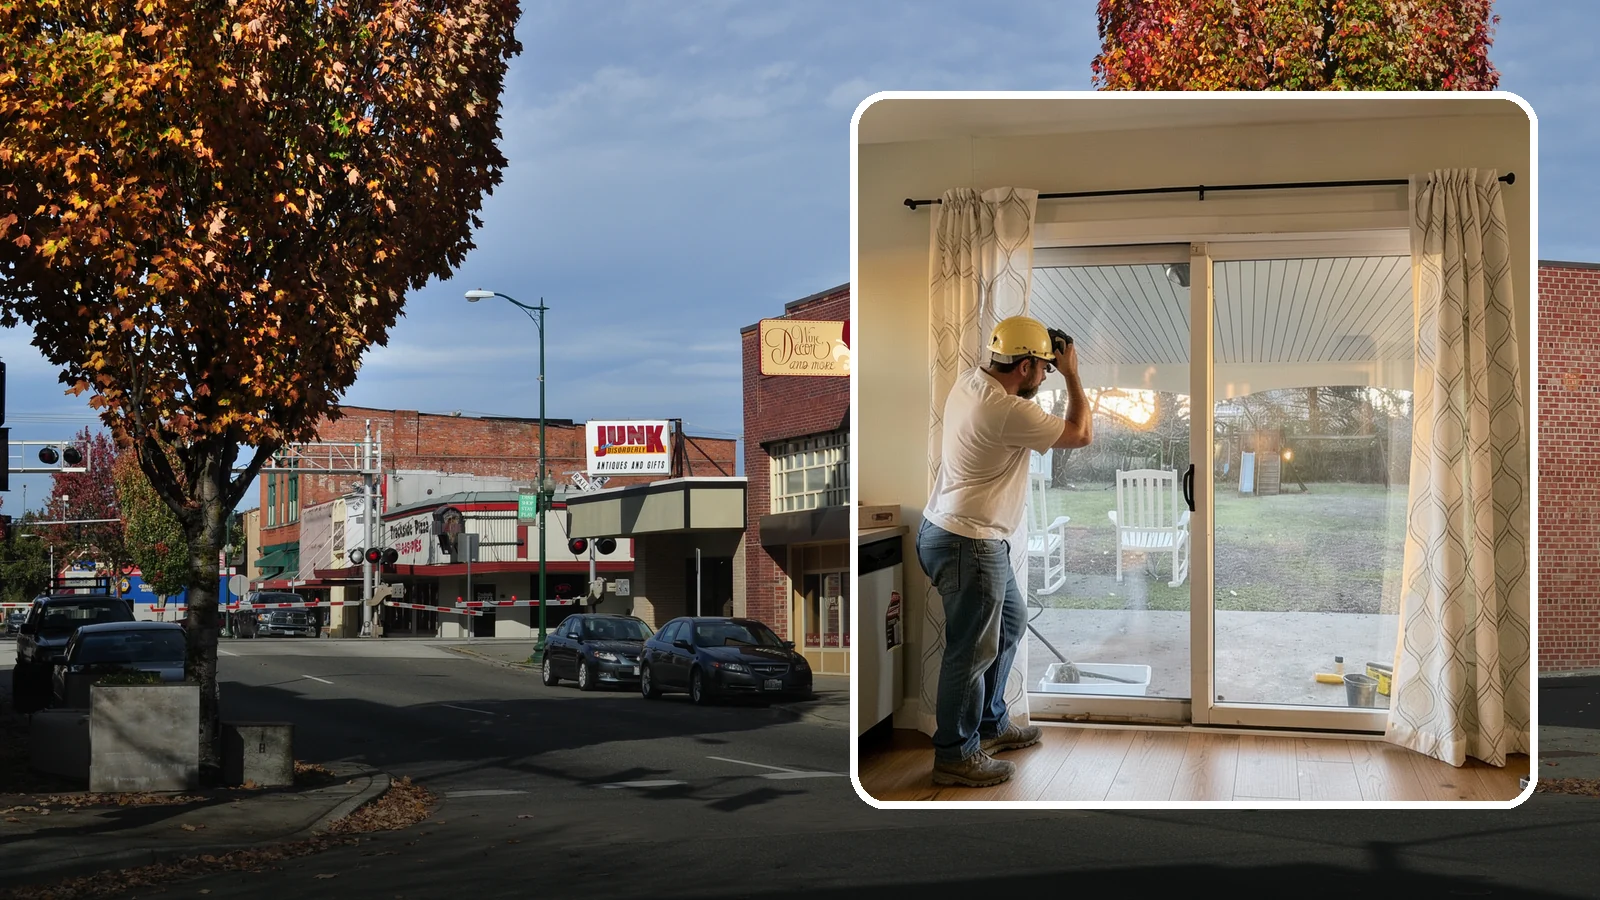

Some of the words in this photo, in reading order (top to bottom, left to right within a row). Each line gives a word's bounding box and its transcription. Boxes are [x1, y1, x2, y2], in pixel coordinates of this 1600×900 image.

[765, 327, 831, 365] Decor
[595, 425, 665, 457] JUNK
[607, 446, 645, 454] DISORDERLY
[596, 461, 628, 470] ANTIQUES
[631, 461, 643, 470] AND
[646, 460, 665, 469] GIFTS
[414, 519, 429, 535] Pizza
